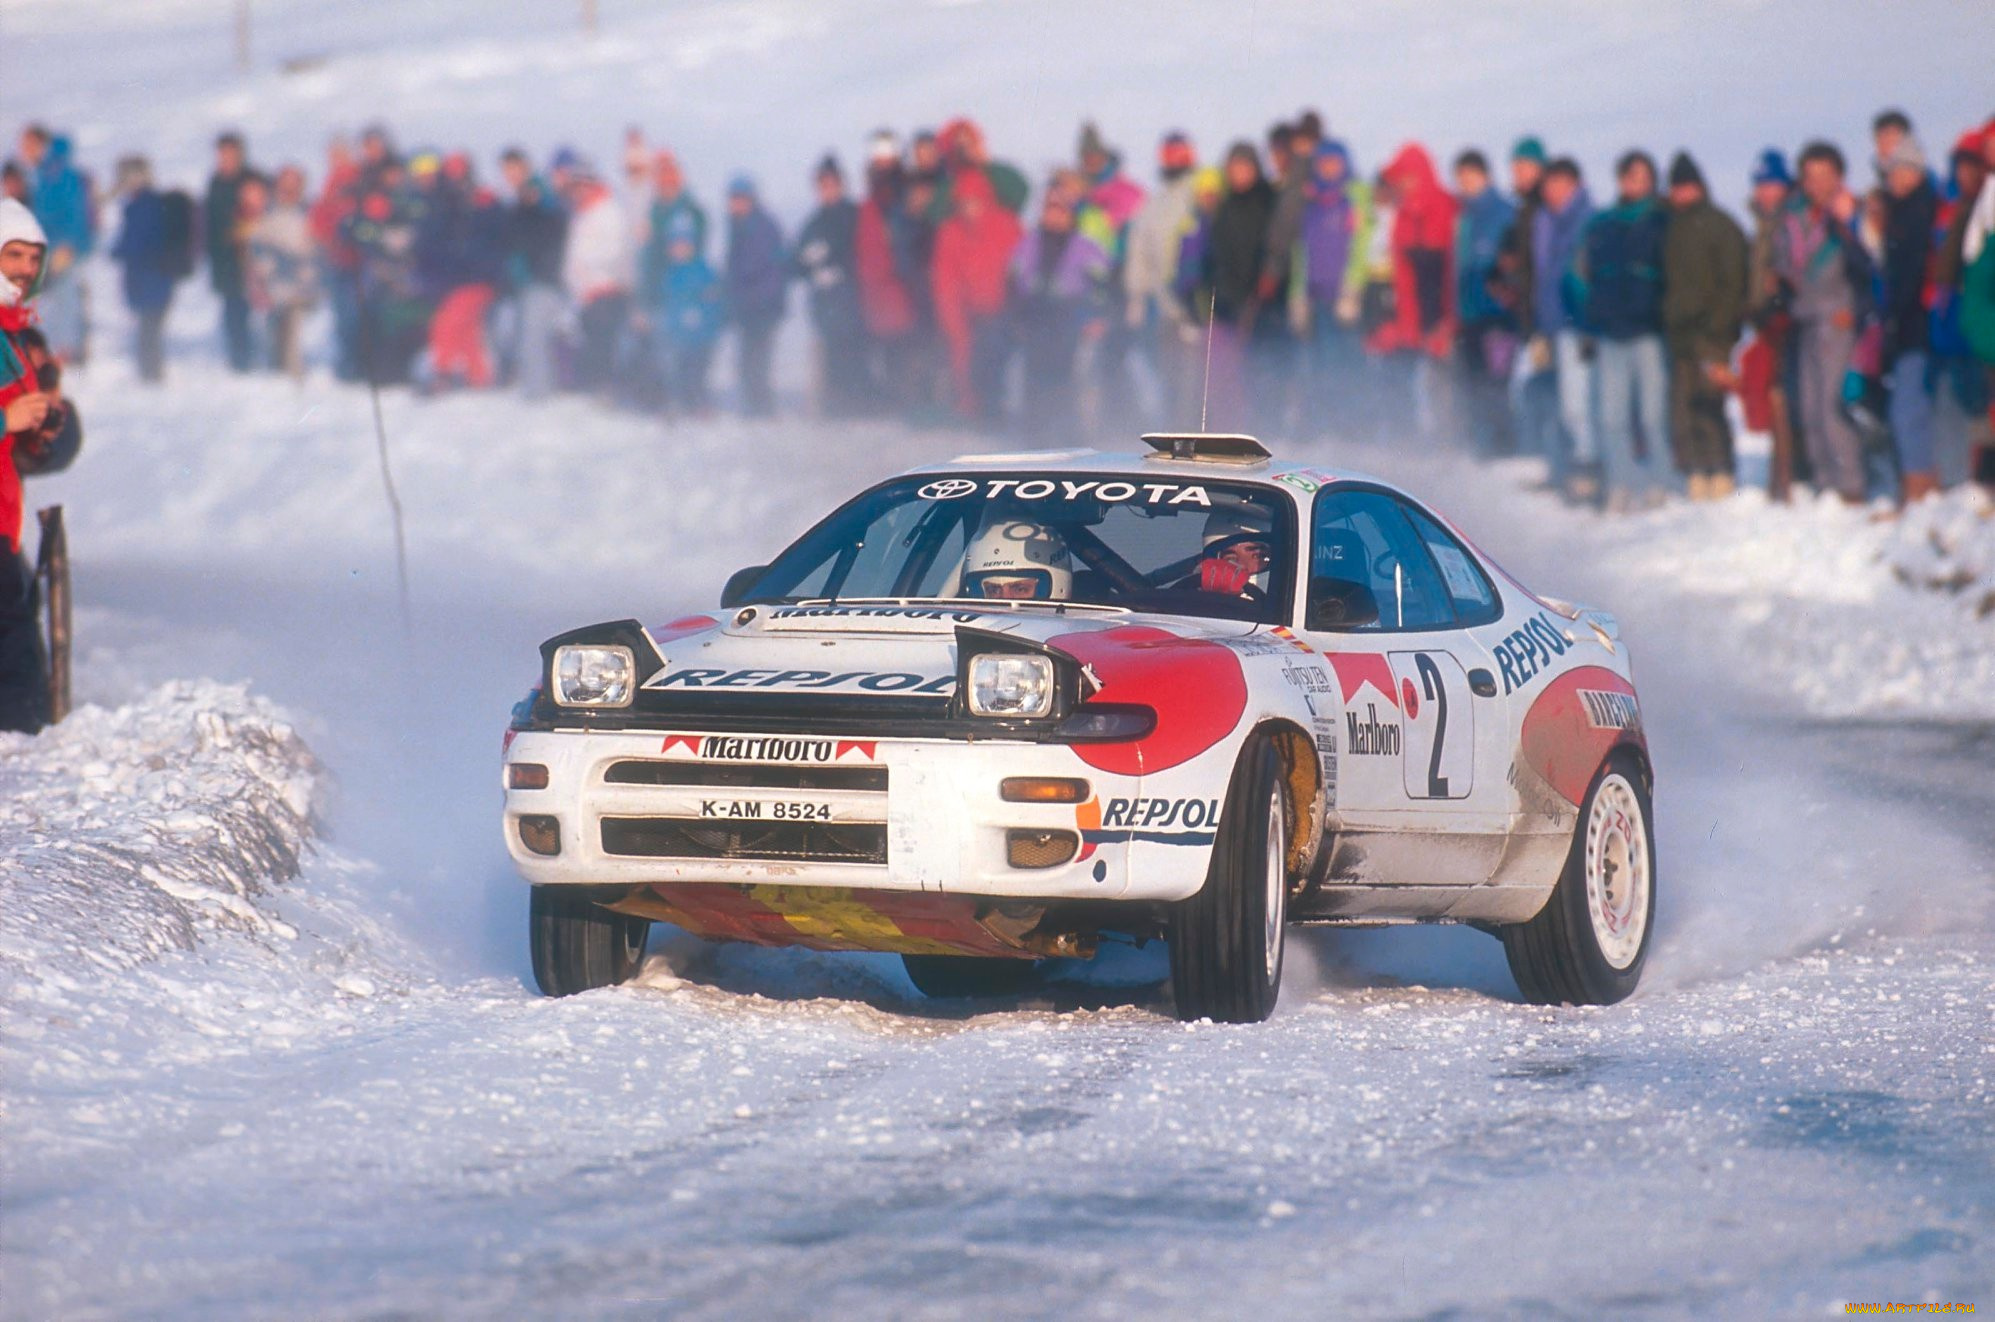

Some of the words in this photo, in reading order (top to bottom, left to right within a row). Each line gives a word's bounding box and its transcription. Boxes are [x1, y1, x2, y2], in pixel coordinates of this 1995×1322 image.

[985, 480, 1212, 506] TOYOTA
[1315, 545, 1343, 560] INZ
[1493, 611, 1574, 696] REPSOL
[650, 669, 957, 693] REPSOL
[1346, 703, 1400, 756] Marlboro
[1414, 653, 1449, 797] 2
[702, 736, 832, 762] Marlboro
[701, 800, 761, 818] K-AM
[773, 802, 831, 820] 8524
[1102, 798, 1220, 828] REPSOL
